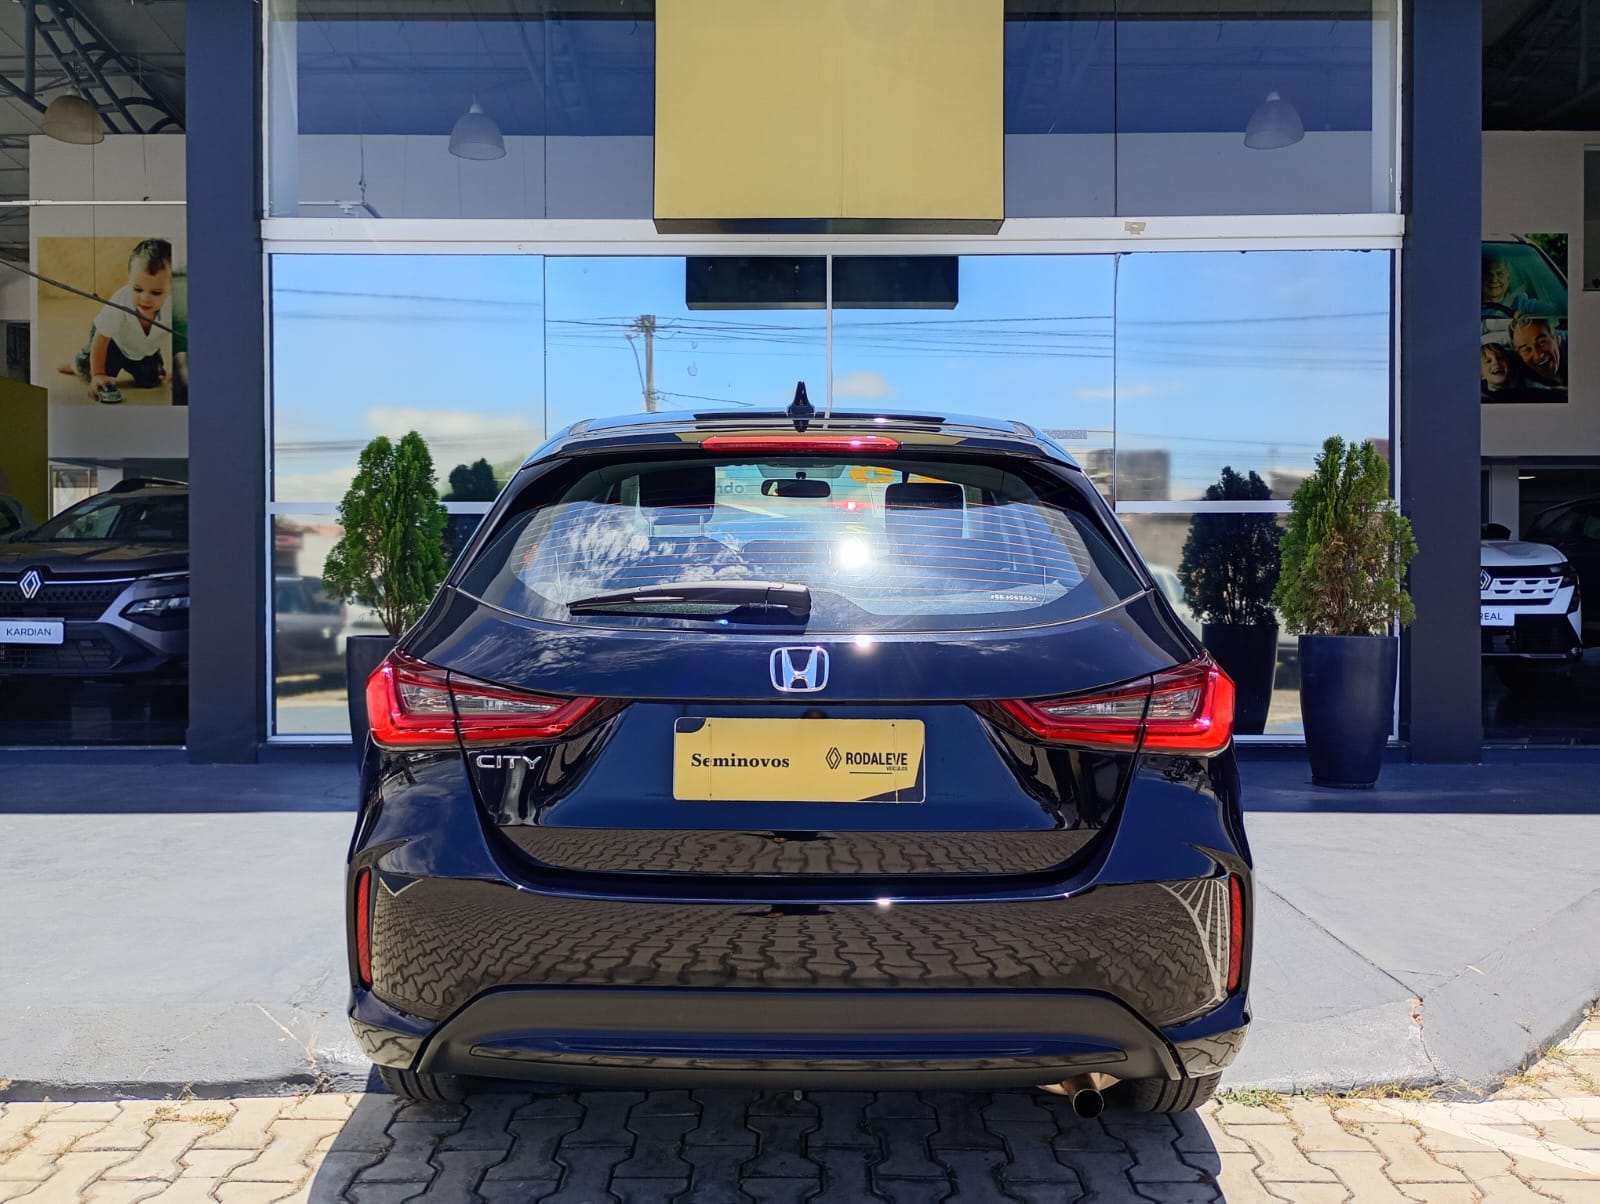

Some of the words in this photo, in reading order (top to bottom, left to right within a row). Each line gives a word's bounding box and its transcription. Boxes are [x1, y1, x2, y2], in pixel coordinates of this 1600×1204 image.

[6, 627, 52, 637] KARDIAN
[476, 754, 542, 770] CITY
[691, 752, 790, 768] Seminovos
[845, 752, 908, 766] RODALEVE
